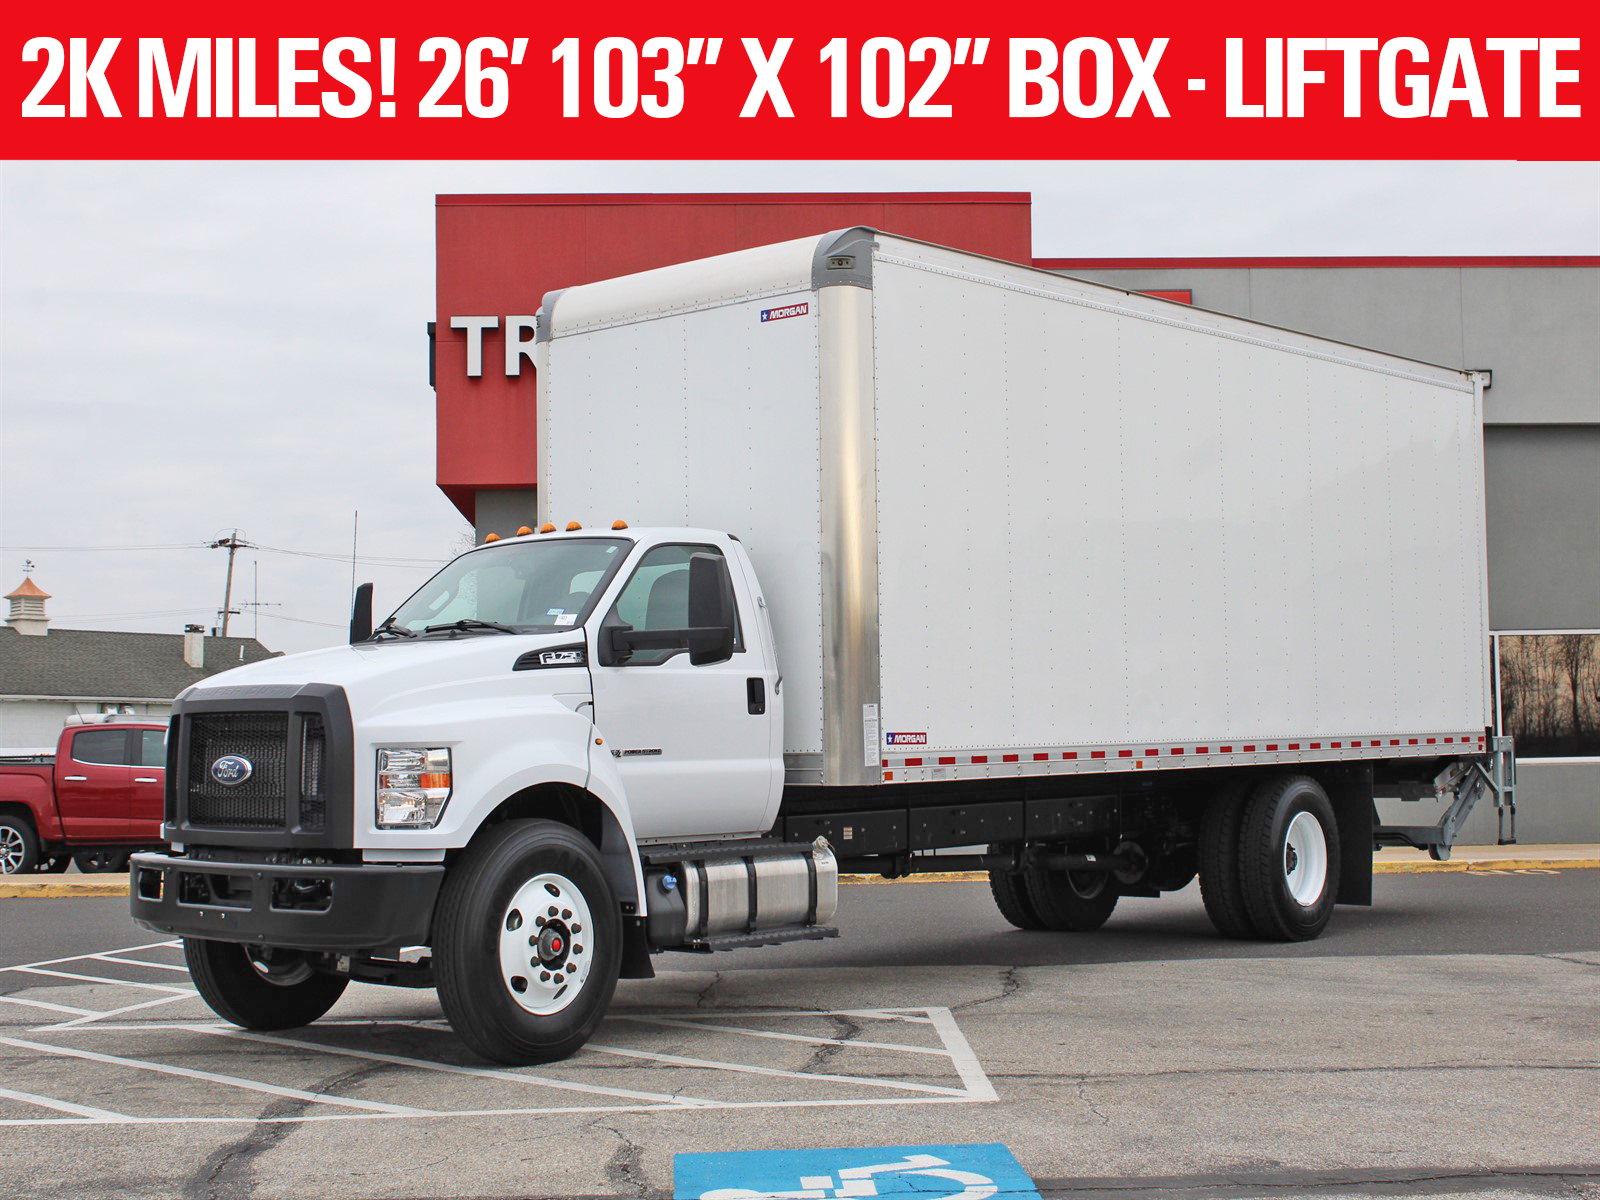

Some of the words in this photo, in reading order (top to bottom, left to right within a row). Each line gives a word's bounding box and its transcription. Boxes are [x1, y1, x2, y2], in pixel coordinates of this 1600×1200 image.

[769, 304, 808, 320] MORGAN
[893, 734, 927, 744] MORGAN
[217, 760, 240, 778] Ford
